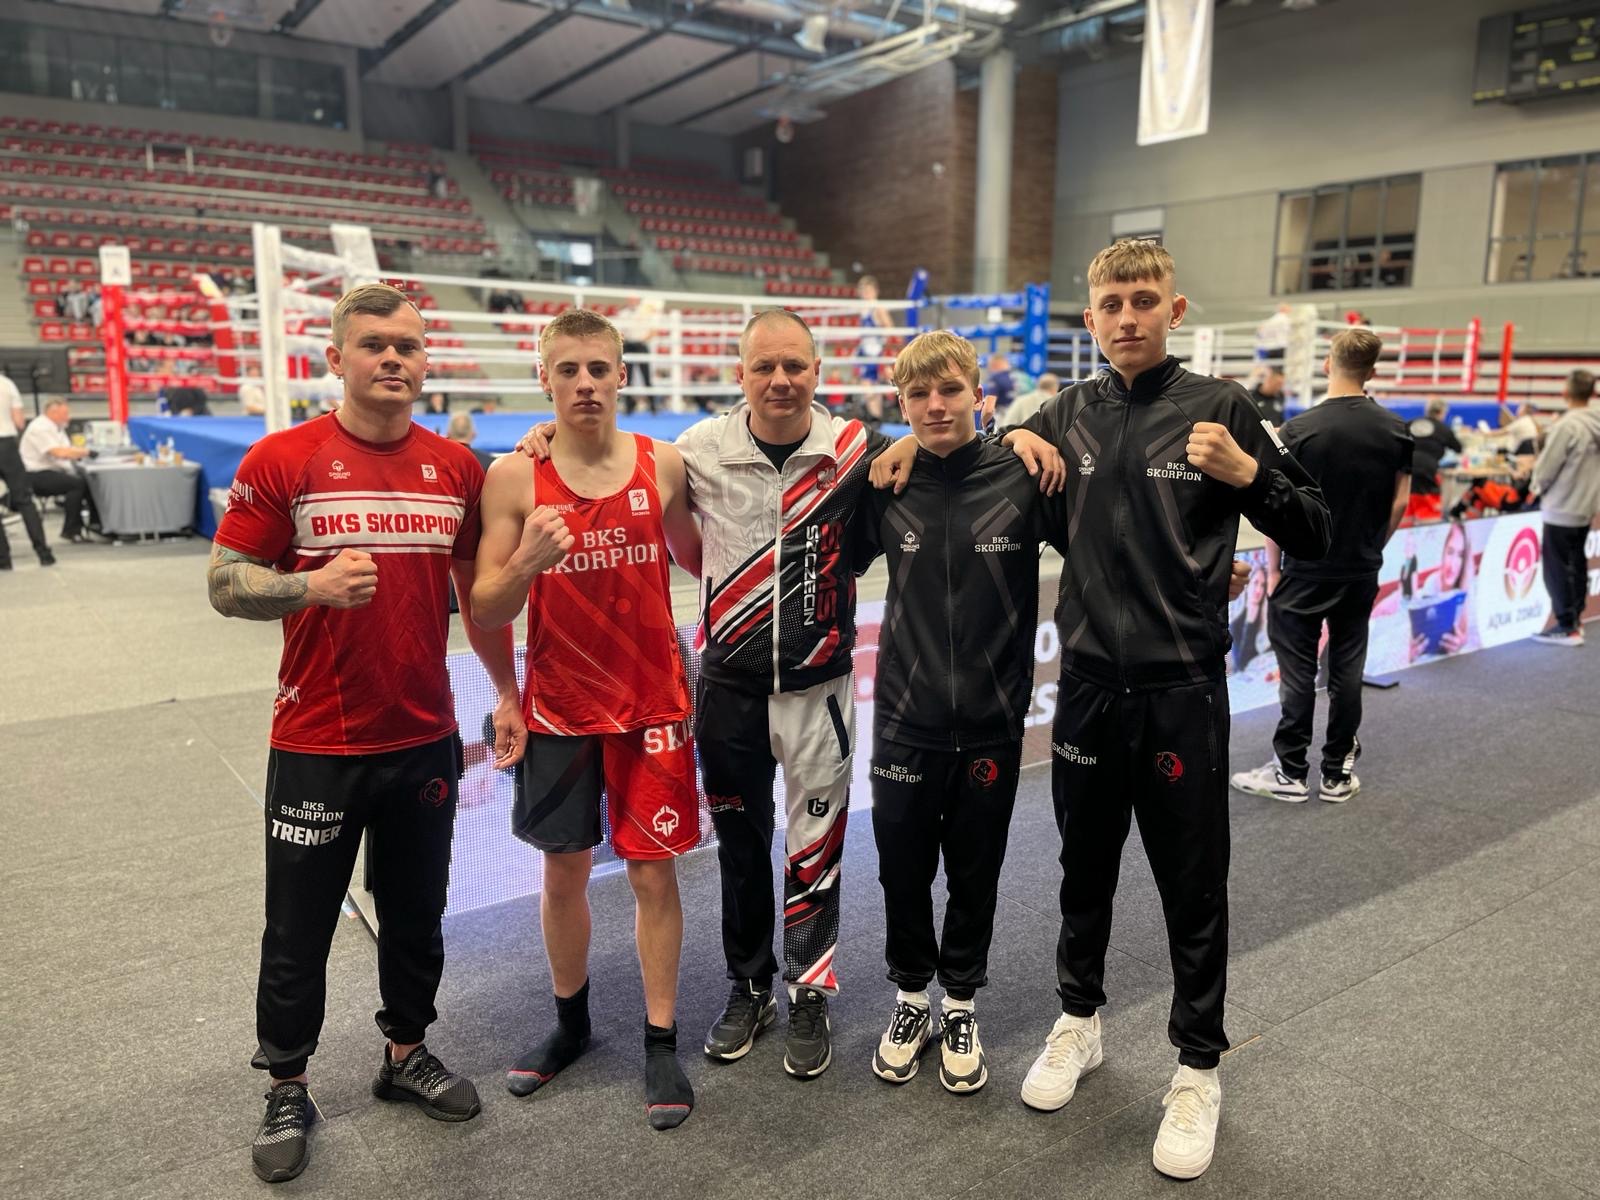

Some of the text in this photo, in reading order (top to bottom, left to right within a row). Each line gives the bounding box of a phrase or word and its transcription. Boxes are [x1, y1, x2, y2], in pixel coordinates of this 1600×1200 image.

[1146, 468, 1202, 481] SKORPION
[1166, 462, 1186, 471] BKS
[311, 513, 361, 537] BKS
[582, 527, 627, 548] BKS
[992, 536, 1009, 544] BKS
[974, 543, 1021, 553] SKORPION
[803, 524, 819, 626] SZCZECIN
[816, 522, 842, 622] SMS
[1051, 742, 1097, 765] SKORPION
[1064, 741, 1080, 754] BKS
[873, 766, 922, 783] SKORPION
[890, 764, 908, 774] BKS
[280, 804, 344, 822] SKORPION
[302, 800, 325, 811] BKS
[271, 818, 342, 846] TRENER
